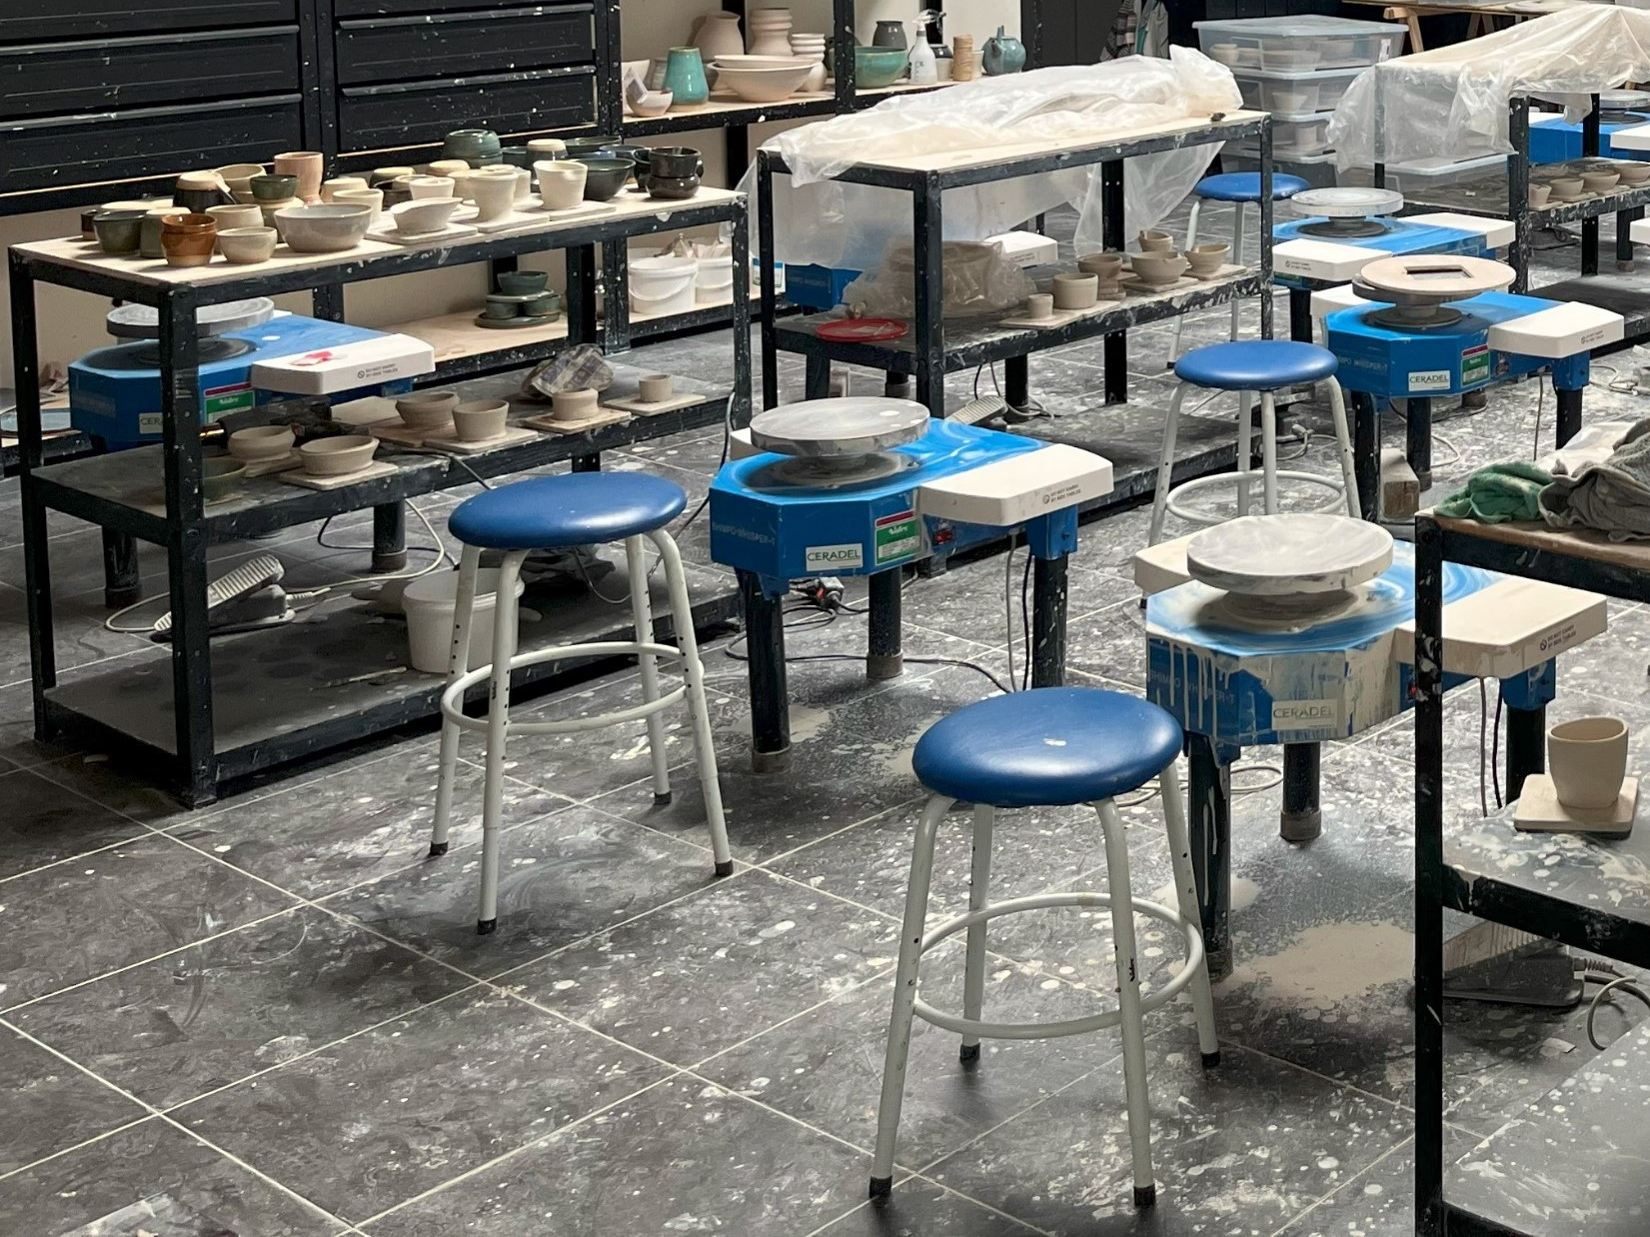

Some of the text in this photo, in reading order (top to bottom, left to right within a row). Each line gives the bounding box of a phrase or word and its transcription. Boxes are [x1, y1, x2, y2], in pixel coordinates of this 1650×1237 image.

[1409, 374, 1449, 384] CERADEL
[807, 549, 861, 561] CERADEL
[1273, 706, 1332, 719] CERADEL
